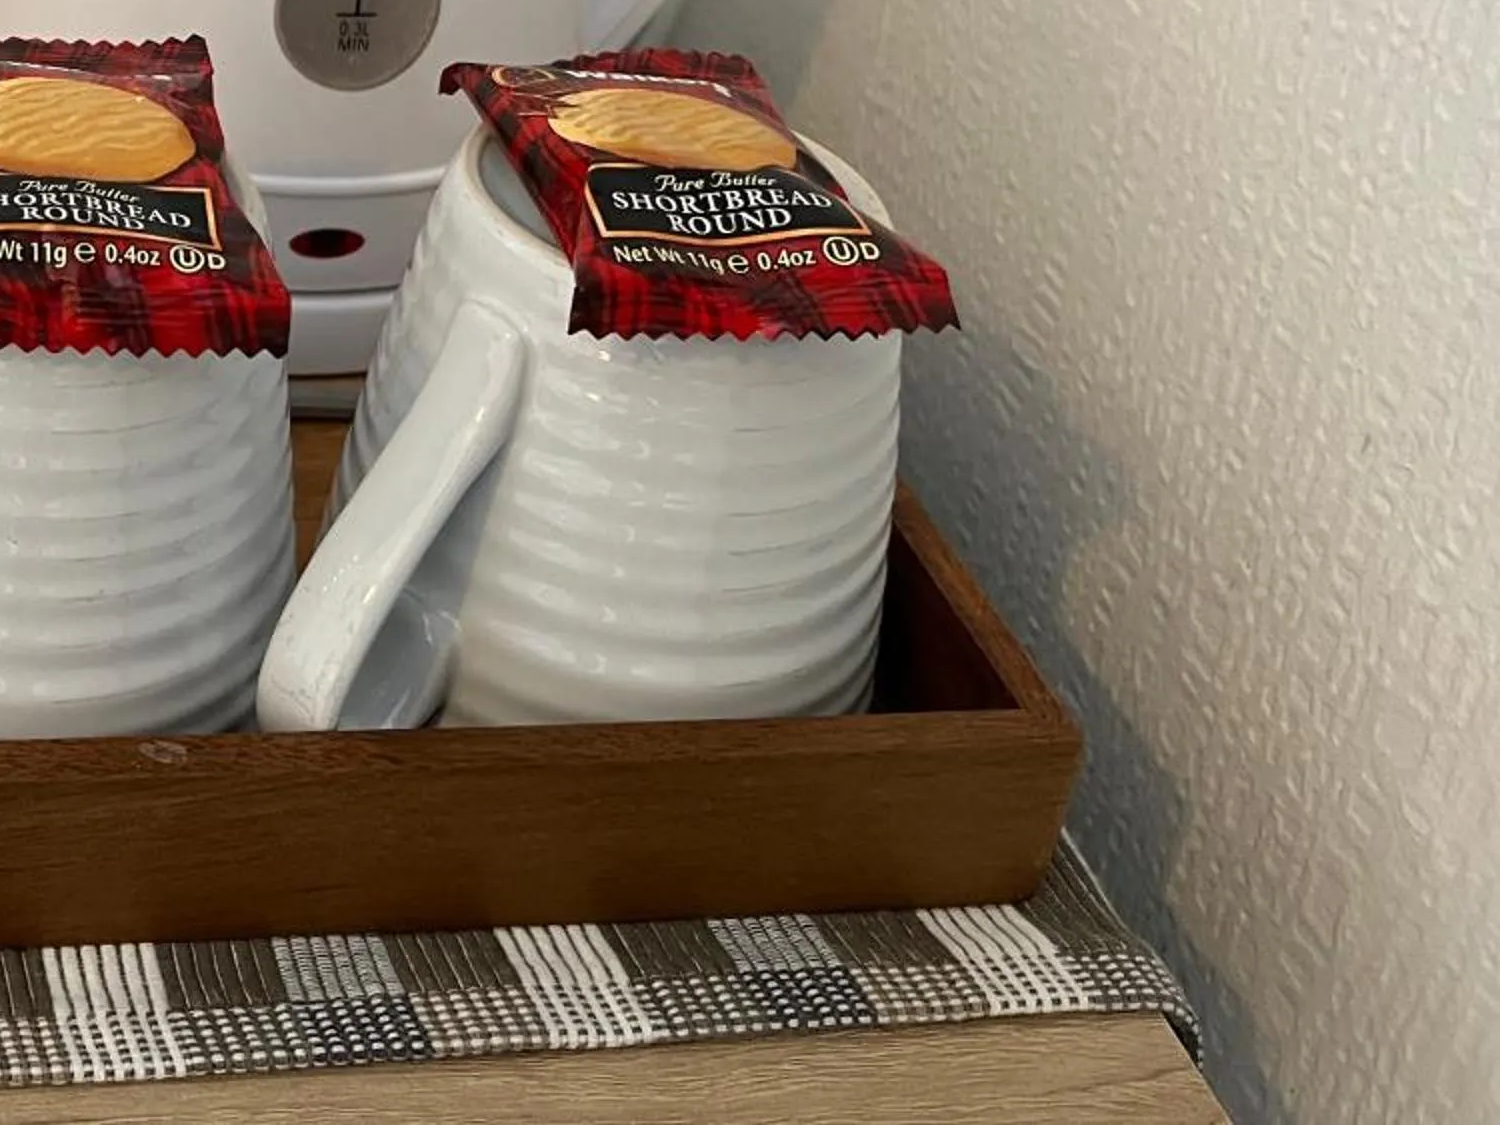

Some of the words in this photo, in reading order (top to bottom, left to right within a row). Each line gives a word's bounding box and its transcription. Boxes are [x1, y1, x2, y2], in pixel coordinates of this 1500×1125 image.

[337, 36, 370, 53] MIN
[19, 179, 69, 192] Pure
[76, 180, 141, 203] Butter
[655, 174, 705, 192] Pure
[611, 189, 833, 215] SHORTBREAD
[22, 206, 145, 230] ROUND
[665, 207, 792, 236] ROUND
[30, 241, 68, 268] 11g
[104, 244, 161, 267] 0.4oz
[613, 245, 652, 264] Net
[653, 246, 685, 266] Wt
[687, 251, 725, 276] 11g
[757, 249, 817, 271] 0.4oz
